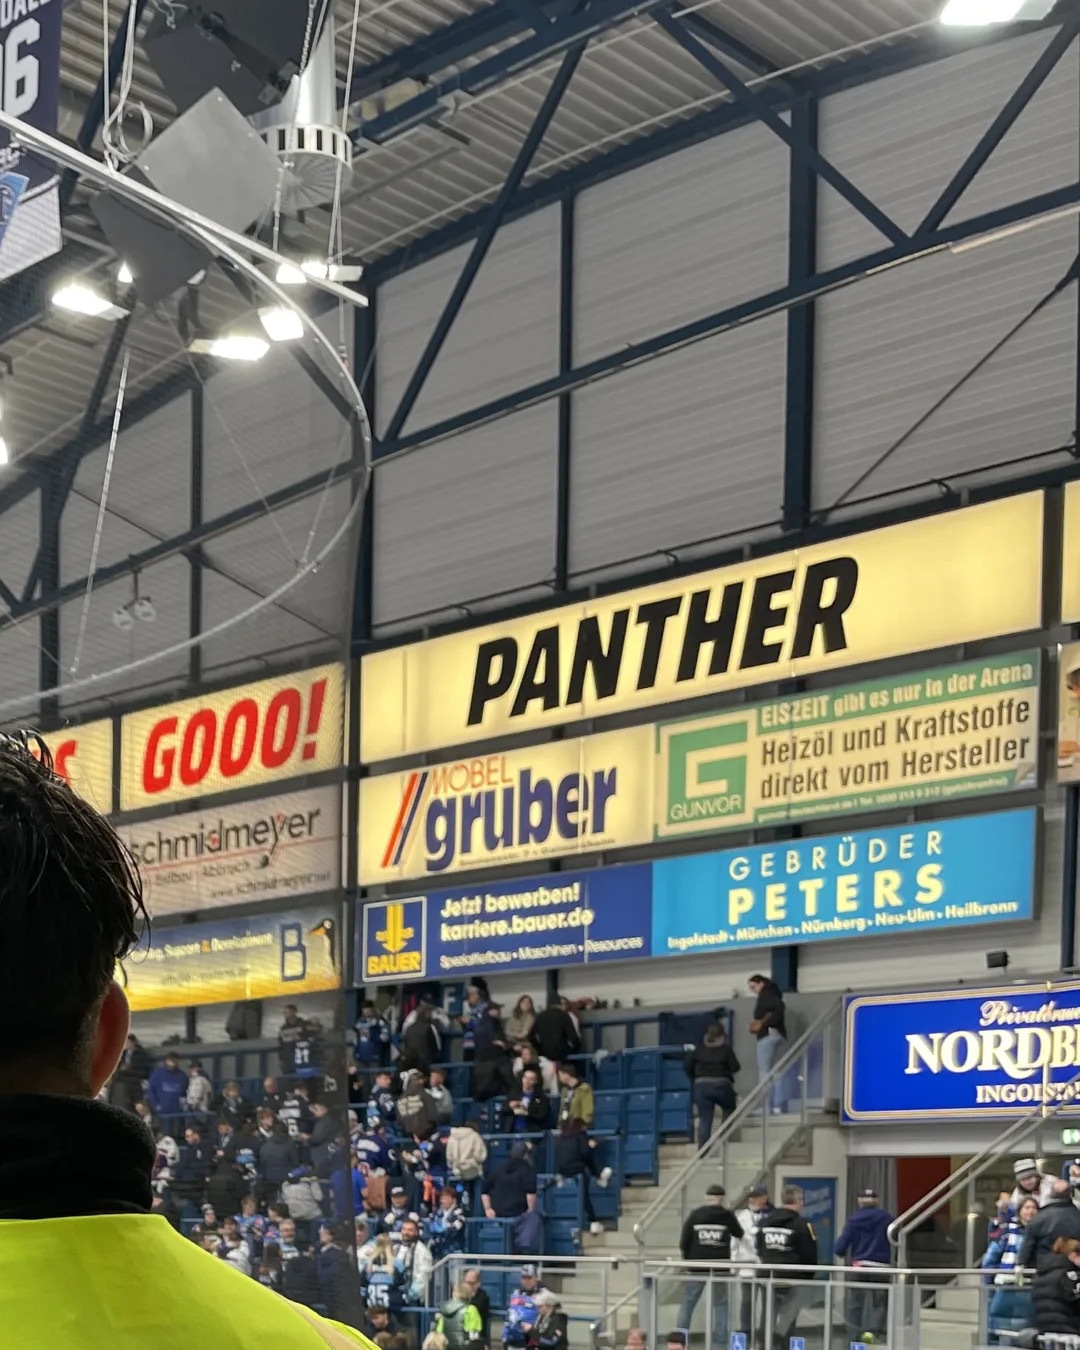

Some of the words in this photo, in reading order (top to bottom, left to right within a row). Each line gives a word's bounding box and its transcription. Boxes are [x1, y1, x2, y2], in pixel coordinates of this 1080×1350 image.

[465, 555, 860, 727] PANTHER
[761, 695, 831, 728] EISZEIT
[834, 691, 865, 717] gibt
[869, 688, 889, 708] es
[893, 684, 922, 704] nur
[926, 677, 943, 698] in
[947, 671, 977, 694] der
[980, 661, 1033, 688] Arena
[142, 678, 328, 795] GOOO!
[761, 729, 833, 766] Heizöl
[843, 720, 886, 753] und
[895, 697, 1031, 744] Kraftstoffe
[431, 756, 513, 795] MÖBEL
[760, 765, 829, 801] direkt
[839, 762, 889, 787] vom
[902, 735, 1031, 778] Hersteller
[425, 765, 618, 872] gruber
[671, 794, 743, 821] GUNVOR
[131, 808, 320, 867] schmidmeyer
[728, 829, 943, 882] GEBRÜDER
[440, 894, 483, 919] Jetzt
[484, 882, 580, 917] bewerben!
[728, 863, 945, 926] PETERS
[280, 922, 307, 982] B
[440, 907, 595, 942] karriere.bauer.de
[518, 944, 578, 962] Maschinen
[584, 935, 644, 954] Resources
[668, 929, 729, 950] Ingolstadt
[736, 924, 793, 943] München
[801, 915, 866, 935] Nürnberg
[875, 908, 935, 928] Neu-Ulm
[945, 900, 1019, 920] Heilbronn
[367, 950, 422, 976] BAUER
[904, 1025, 1080, 1079] NORDB
